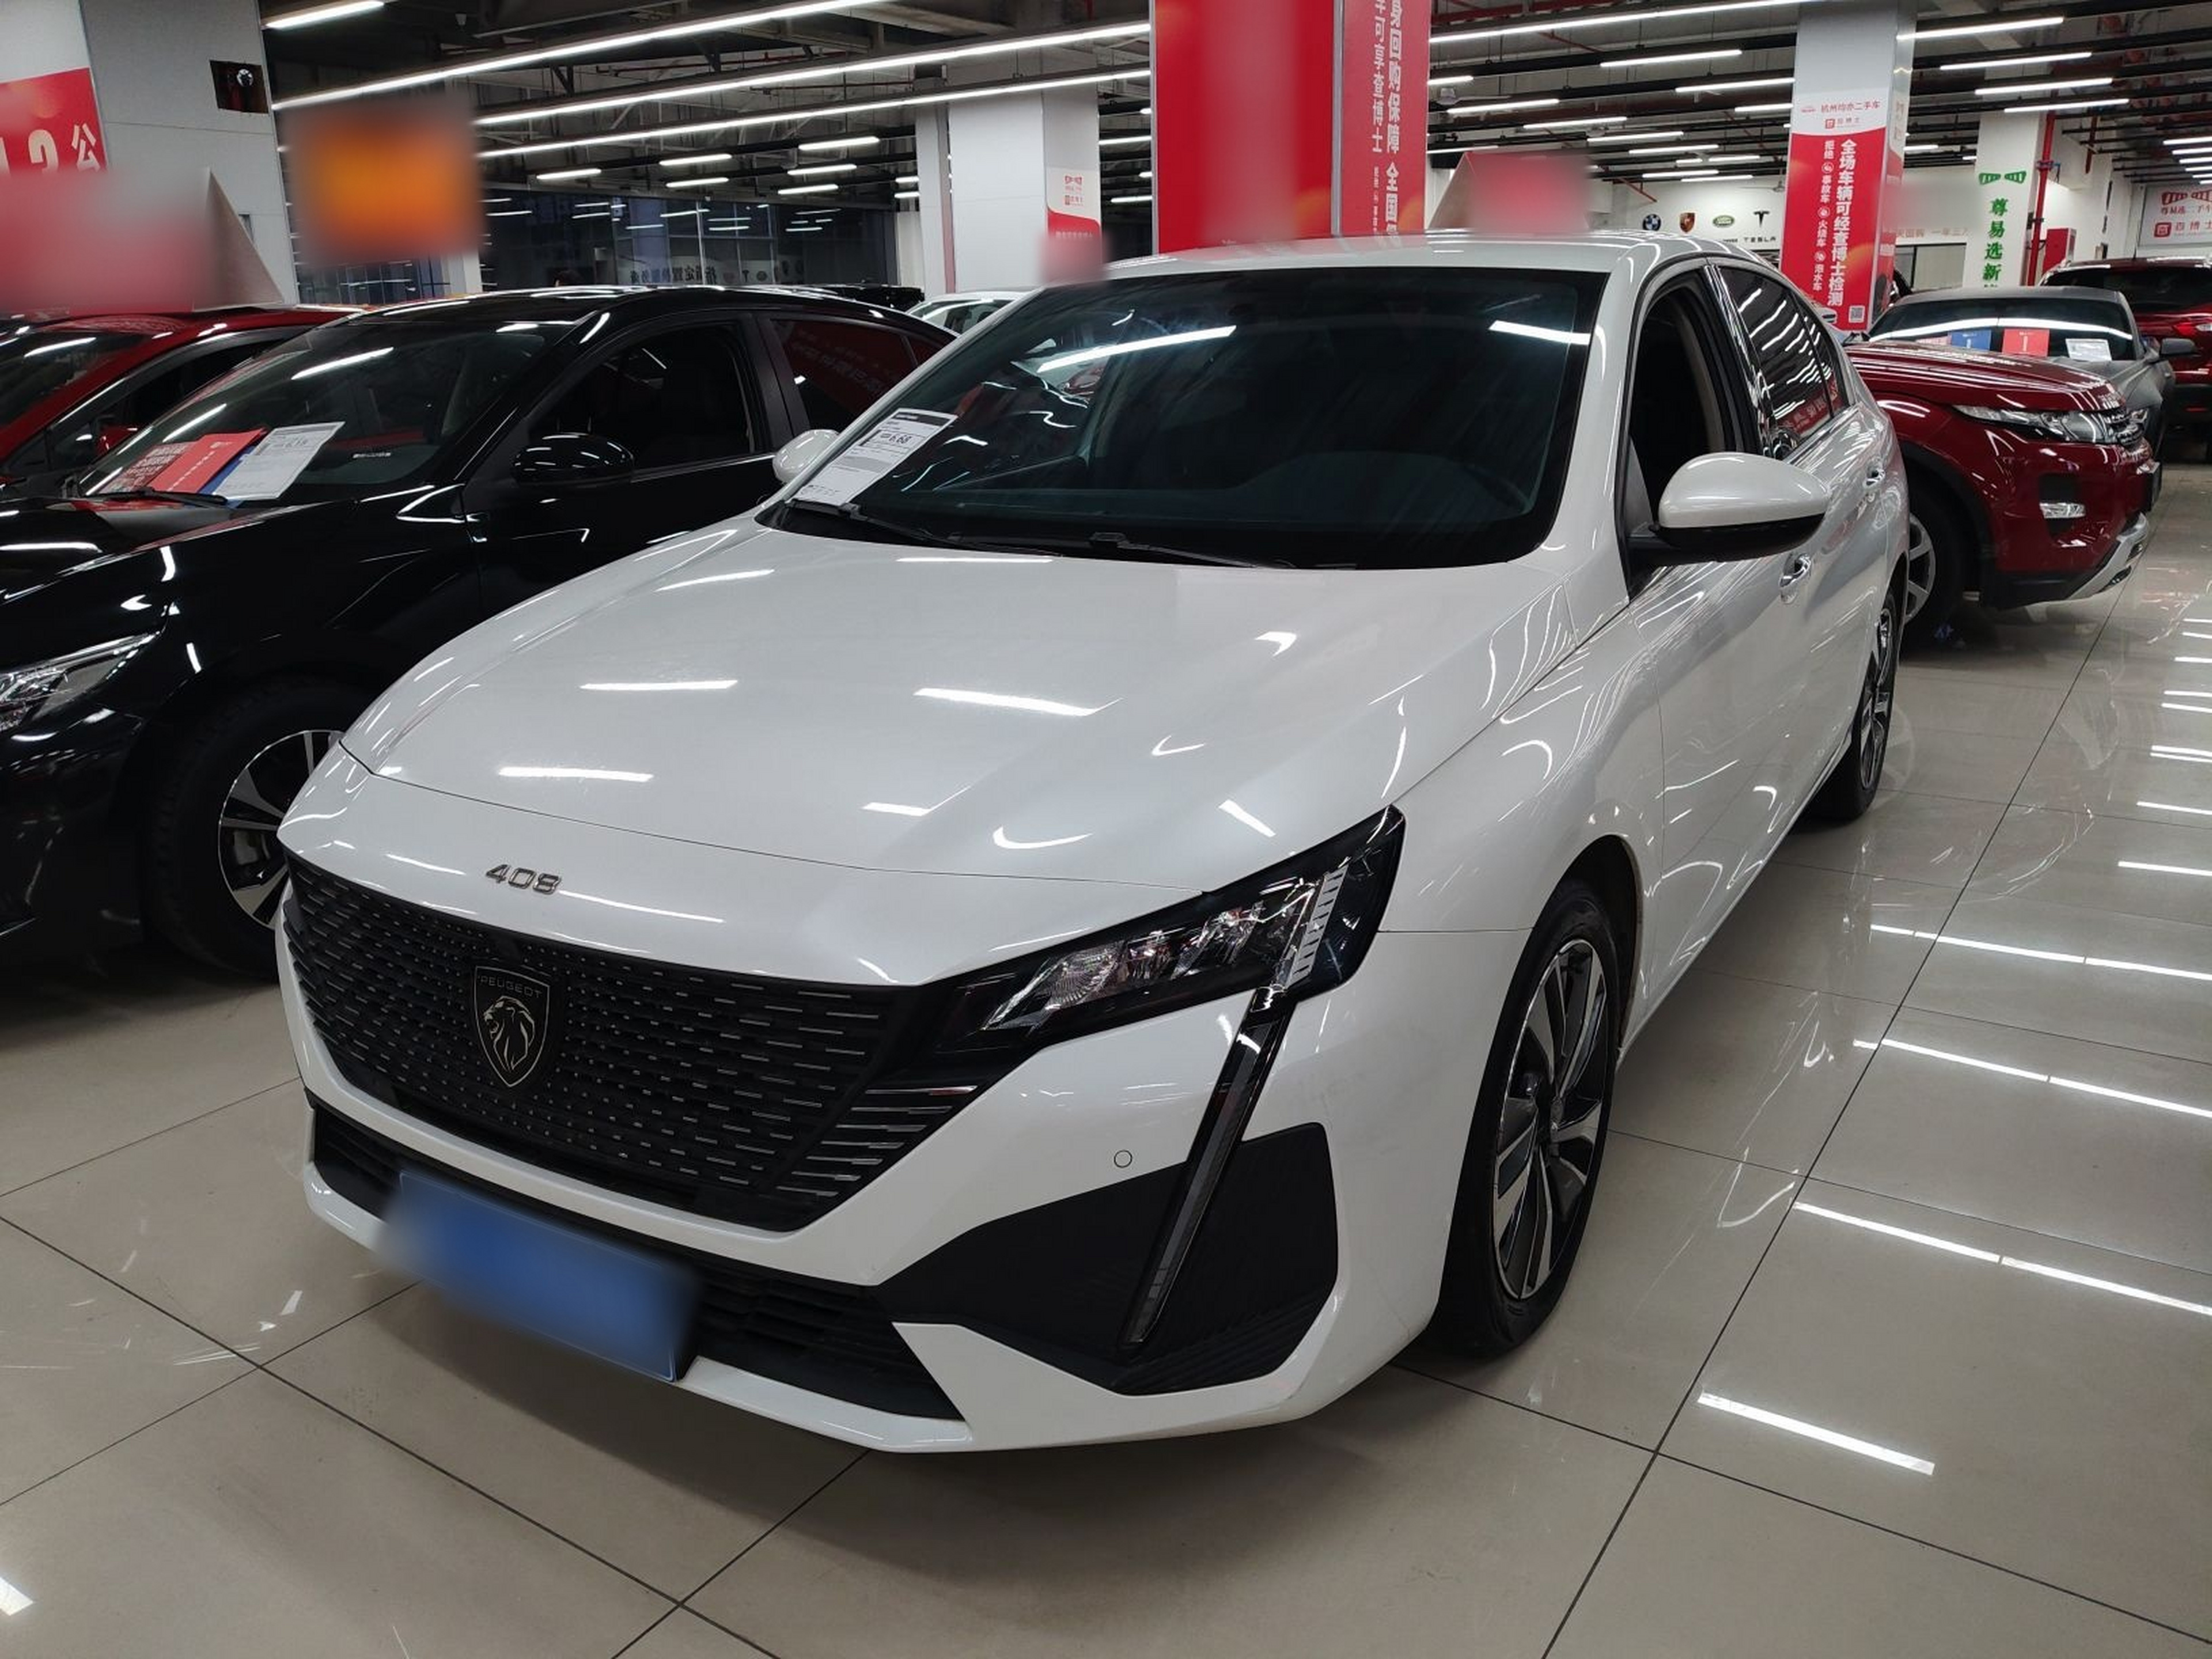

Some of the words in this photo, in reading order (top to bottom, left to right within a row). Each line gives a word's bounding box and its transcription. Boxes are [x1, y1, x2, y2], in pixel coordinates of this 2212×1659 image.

[1827, 139, 1857, 306] 全场车辆可经查博士检测
[1982, 198, 2009, 287] 尊易选新
[486, 864, 562, 895] 408
[480, 975, 543, 998] PEUGEOT
